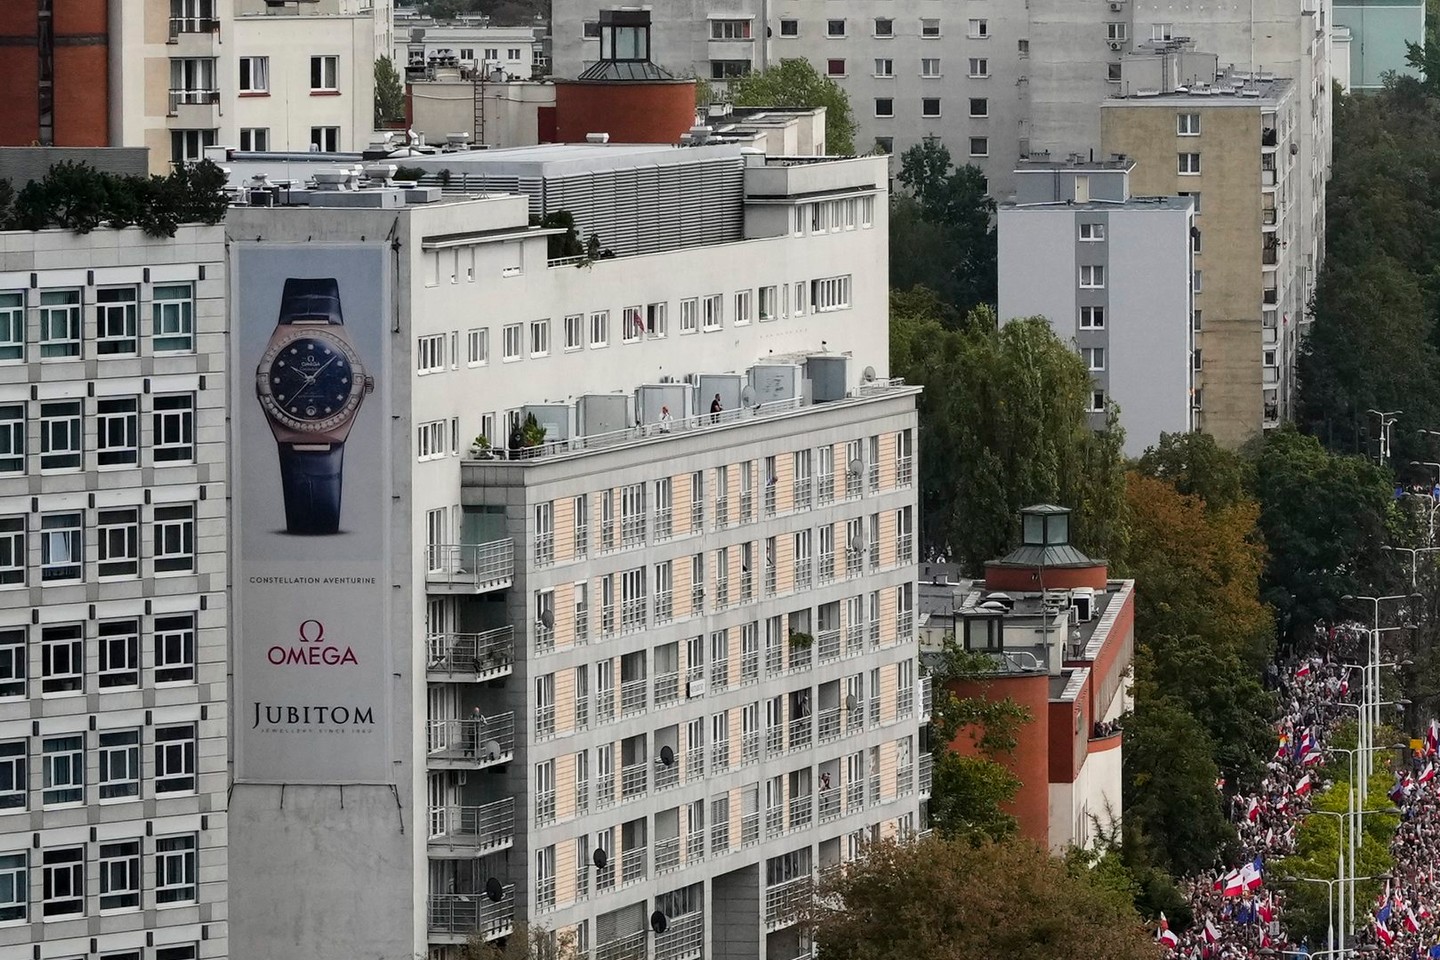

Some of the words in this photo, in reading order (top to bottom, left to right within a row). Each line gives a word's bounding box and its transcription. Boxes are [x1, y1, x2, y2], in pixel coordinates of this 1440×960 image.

[249, 576, 320, 584] CONSTELLATION
[323, 577, 376, 585] AVENTURINE
[267, 646, 358, 665] OMEGA
[252, 702, 375, 729] JUBITOM
